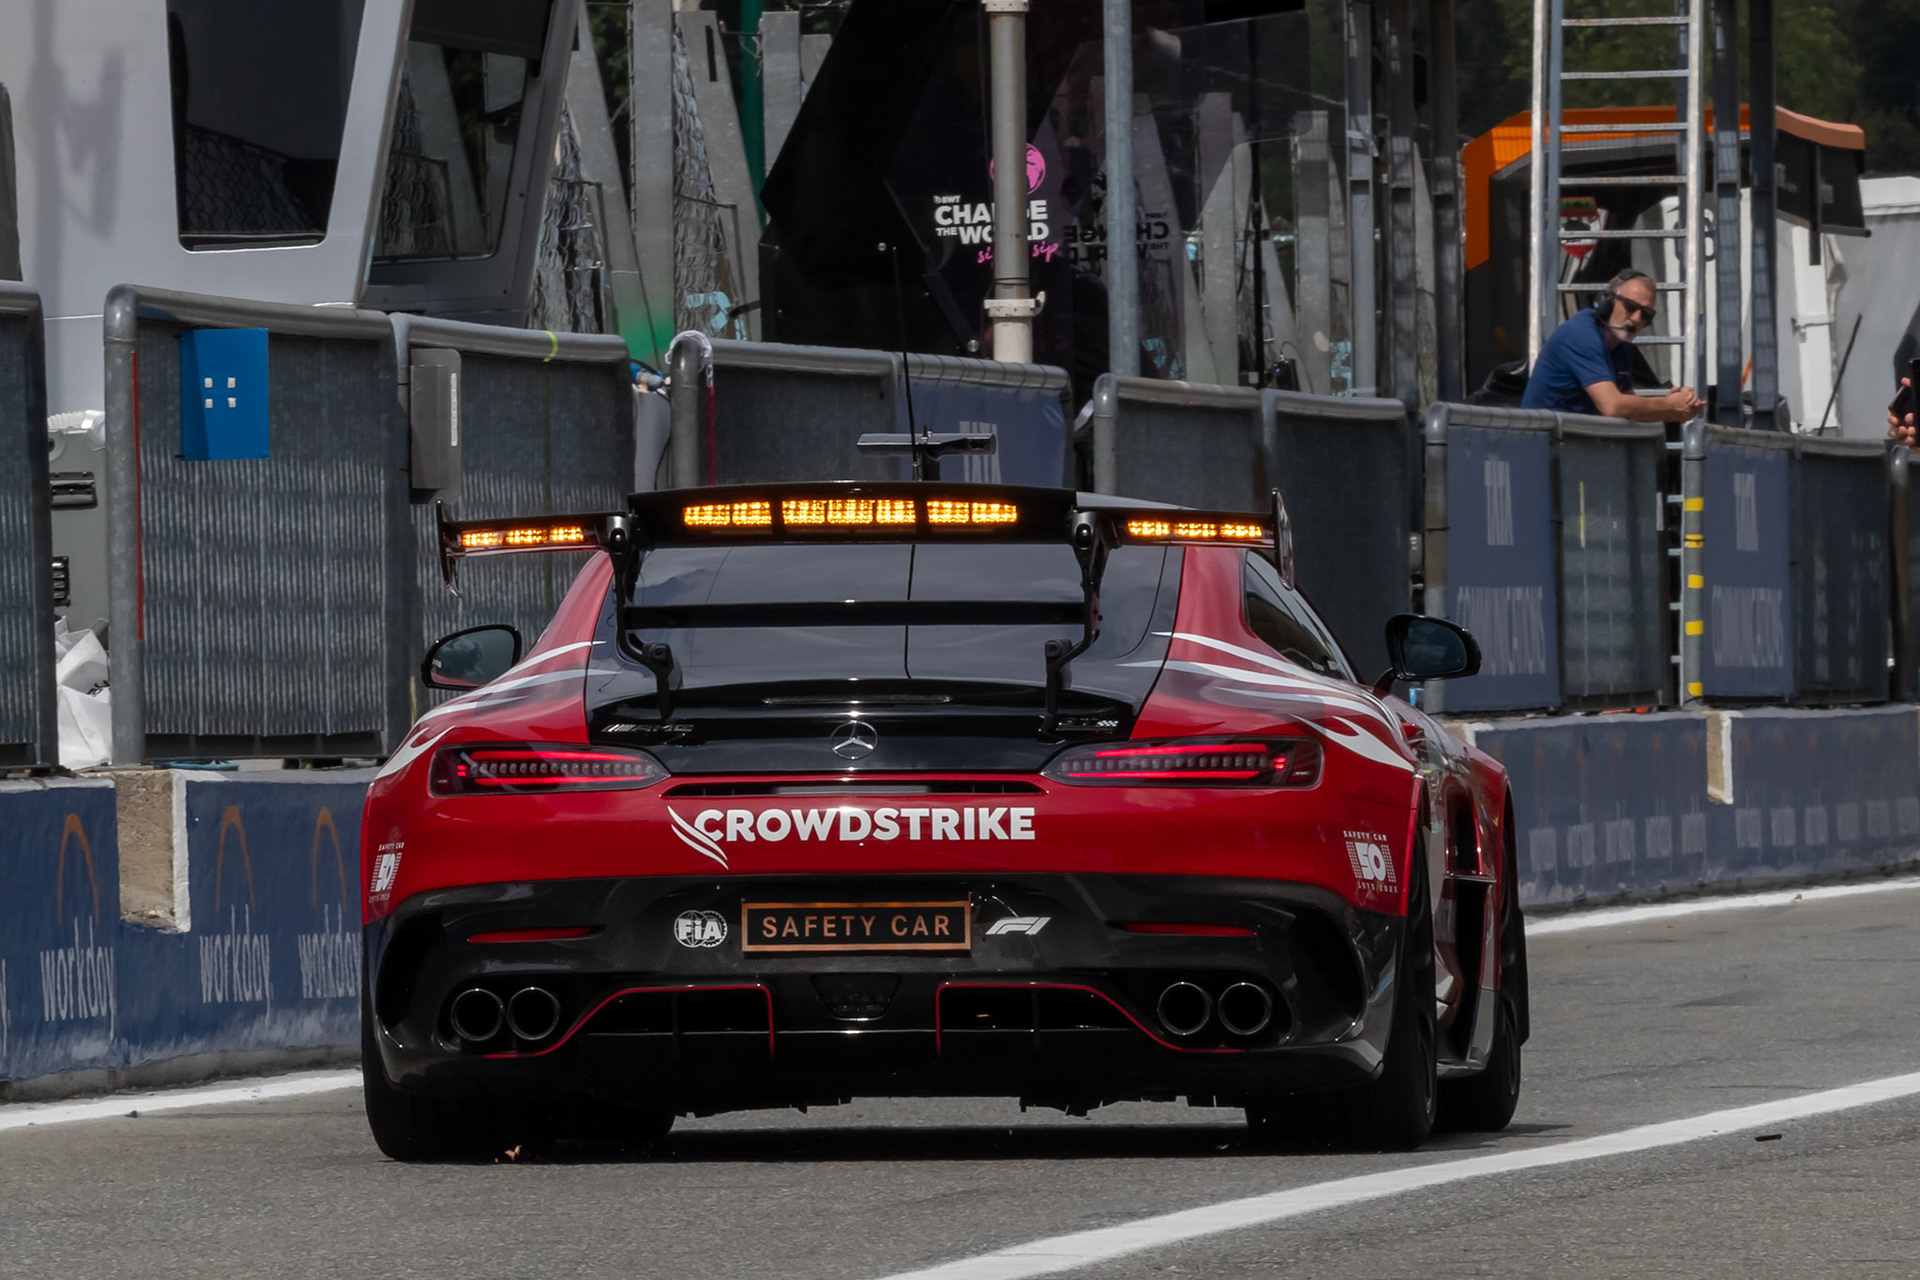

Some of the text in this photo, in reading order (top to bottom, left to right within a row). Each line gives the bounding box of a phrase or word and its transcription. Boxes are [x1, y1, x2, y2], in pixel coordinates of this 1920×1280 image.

[935, 200, 1048, 226] CHAE
[936, 222, 1049, 244] THE WOD
[1032, 240, 1058, 263] sip
[694, 807, 1036, 842] CROWDSTRIKE
[1343, 830, 1387, 841] SAFETY CAR
[374, 853, 396, 892] 50
[1354, 842, 1386, 882] 50
[762, 914, 951, 938] SAFETY CAR
